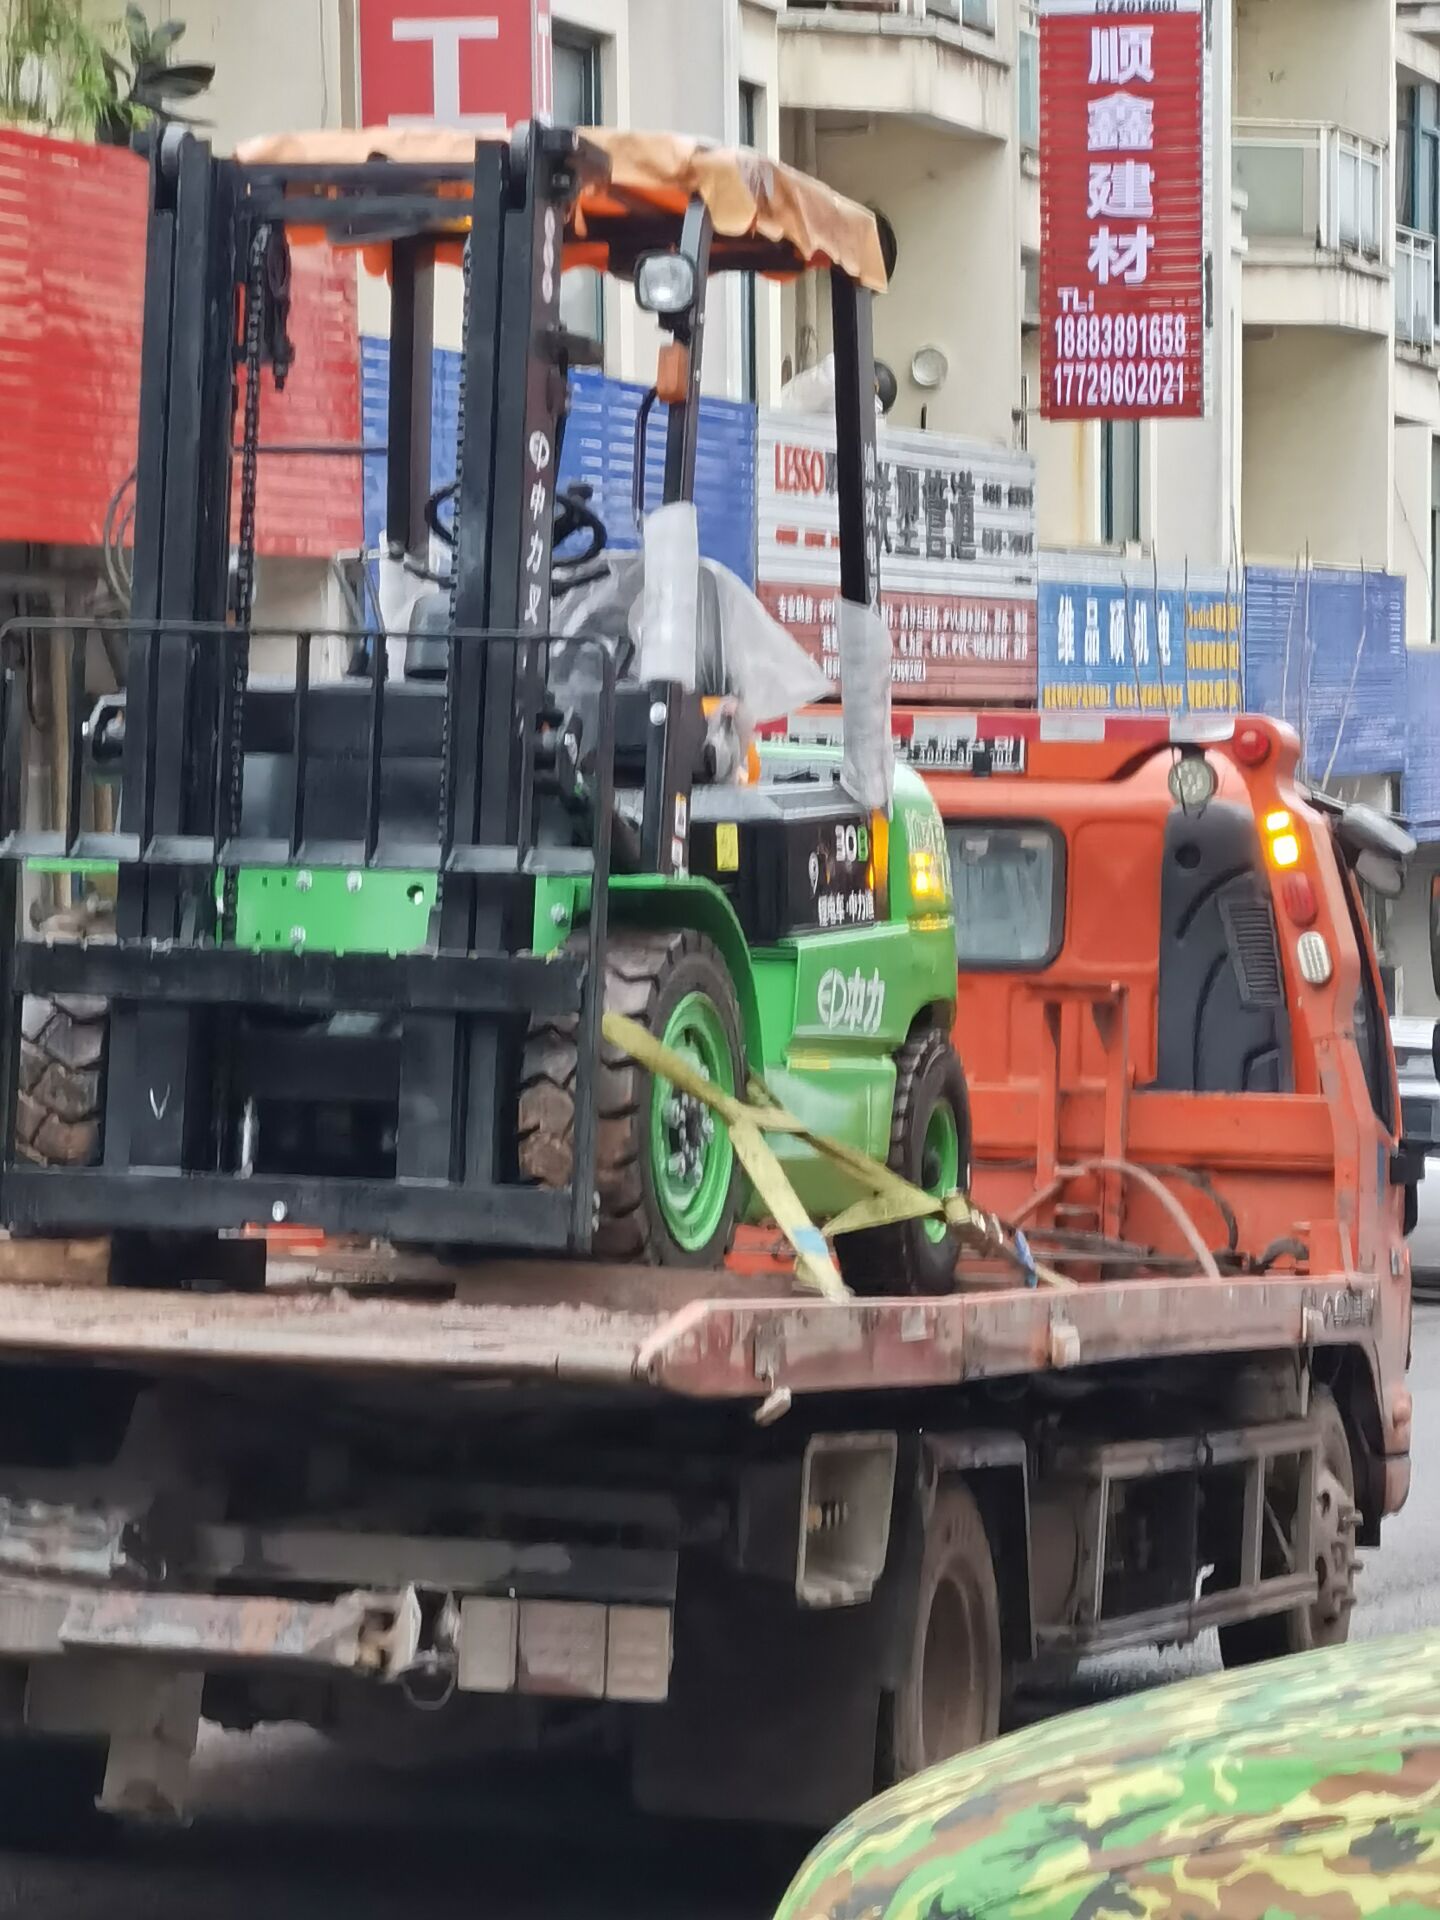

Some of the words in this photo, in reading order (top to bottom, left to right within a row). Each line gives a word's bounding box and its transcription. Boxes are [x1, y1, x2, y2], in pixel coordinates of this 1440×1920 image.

[1087, 24, 1155, 285] 顺鑫建材
[1055, 312, 1186, 359] 18883891658
[1054, 360, 1184, 406] 17729602021
[775, 441, 825, 496] LESSO
